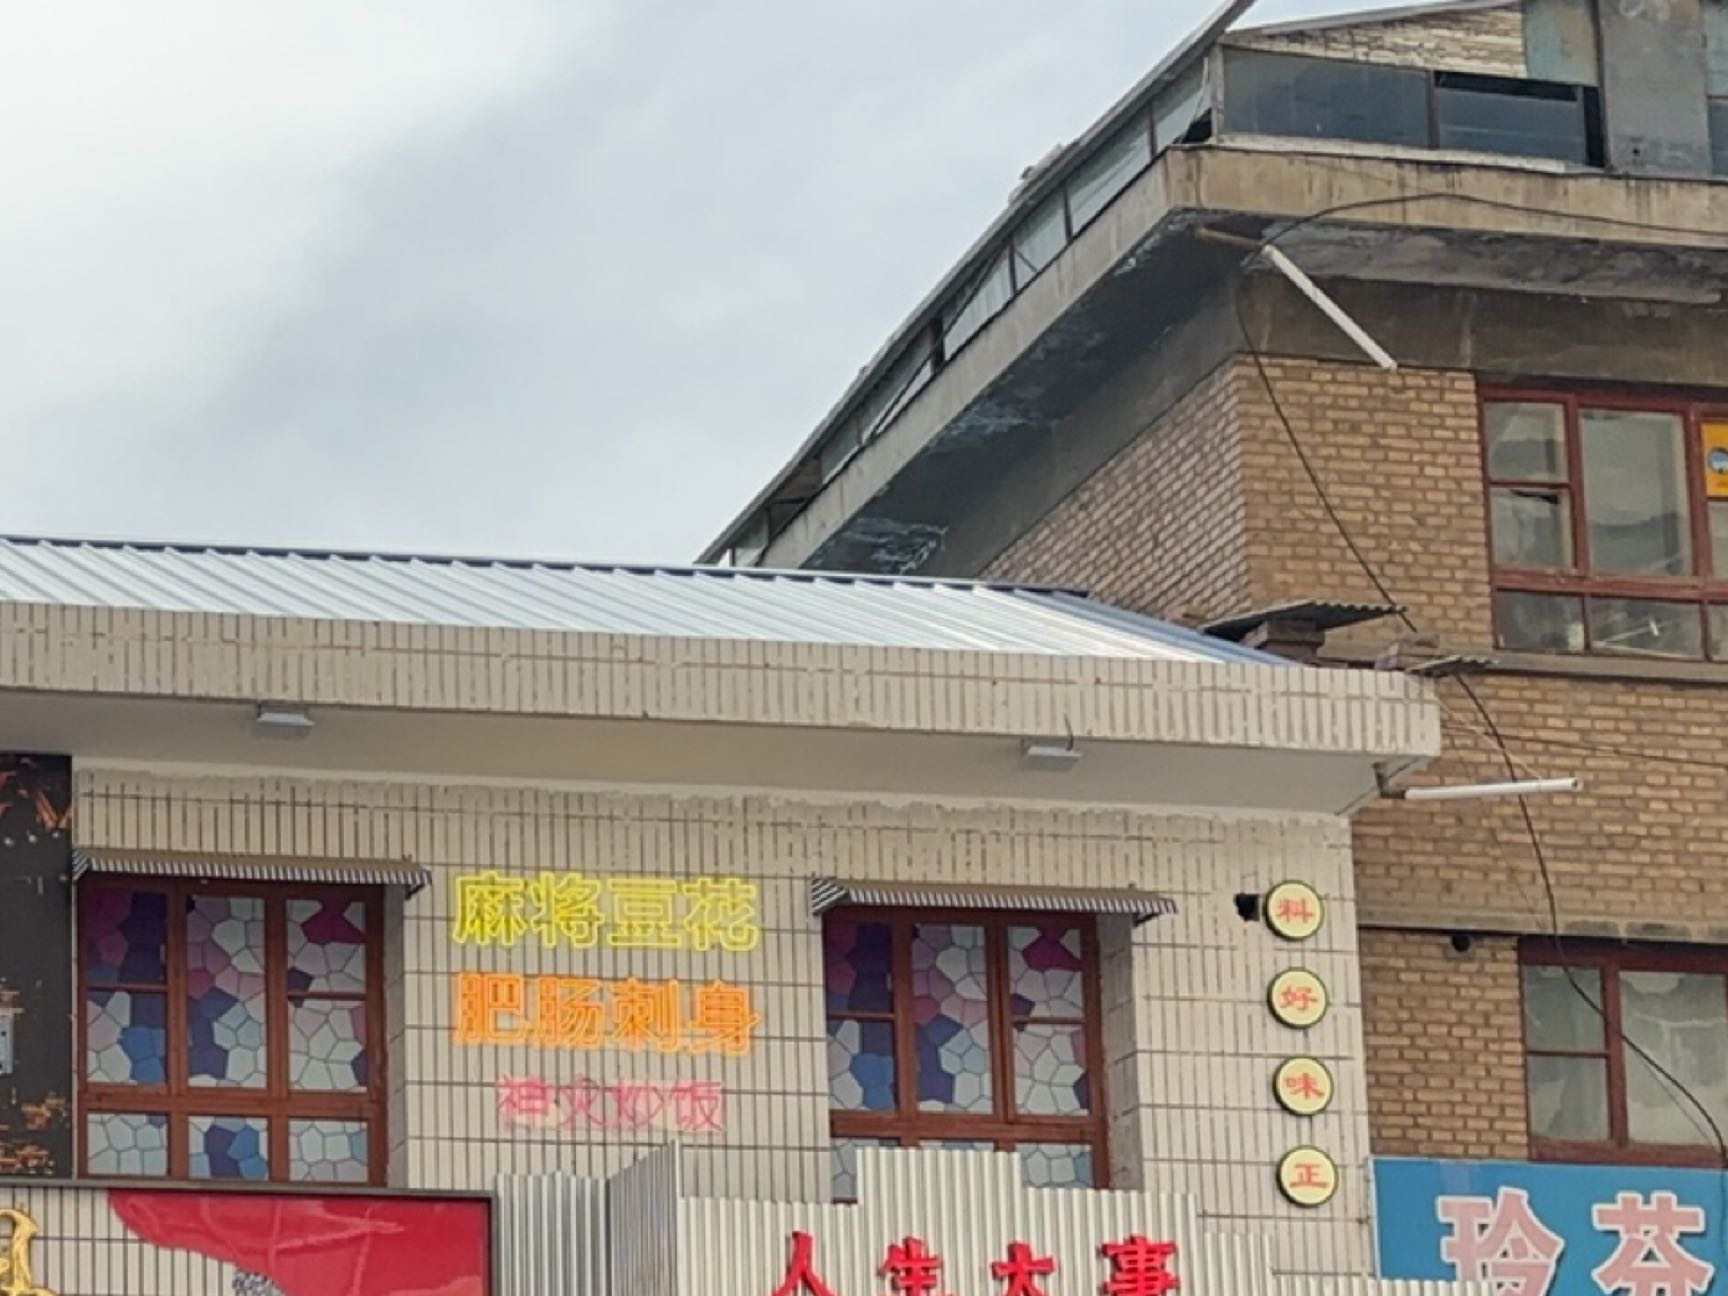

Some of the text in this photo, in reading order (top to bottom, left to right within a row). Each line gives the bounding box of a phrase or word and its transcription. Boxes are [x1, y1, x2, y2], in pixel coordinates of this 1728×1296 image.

[452, 870, 762, 951] 麻将豆花
[453, 972, 761, 1057] 肥肠刺身
